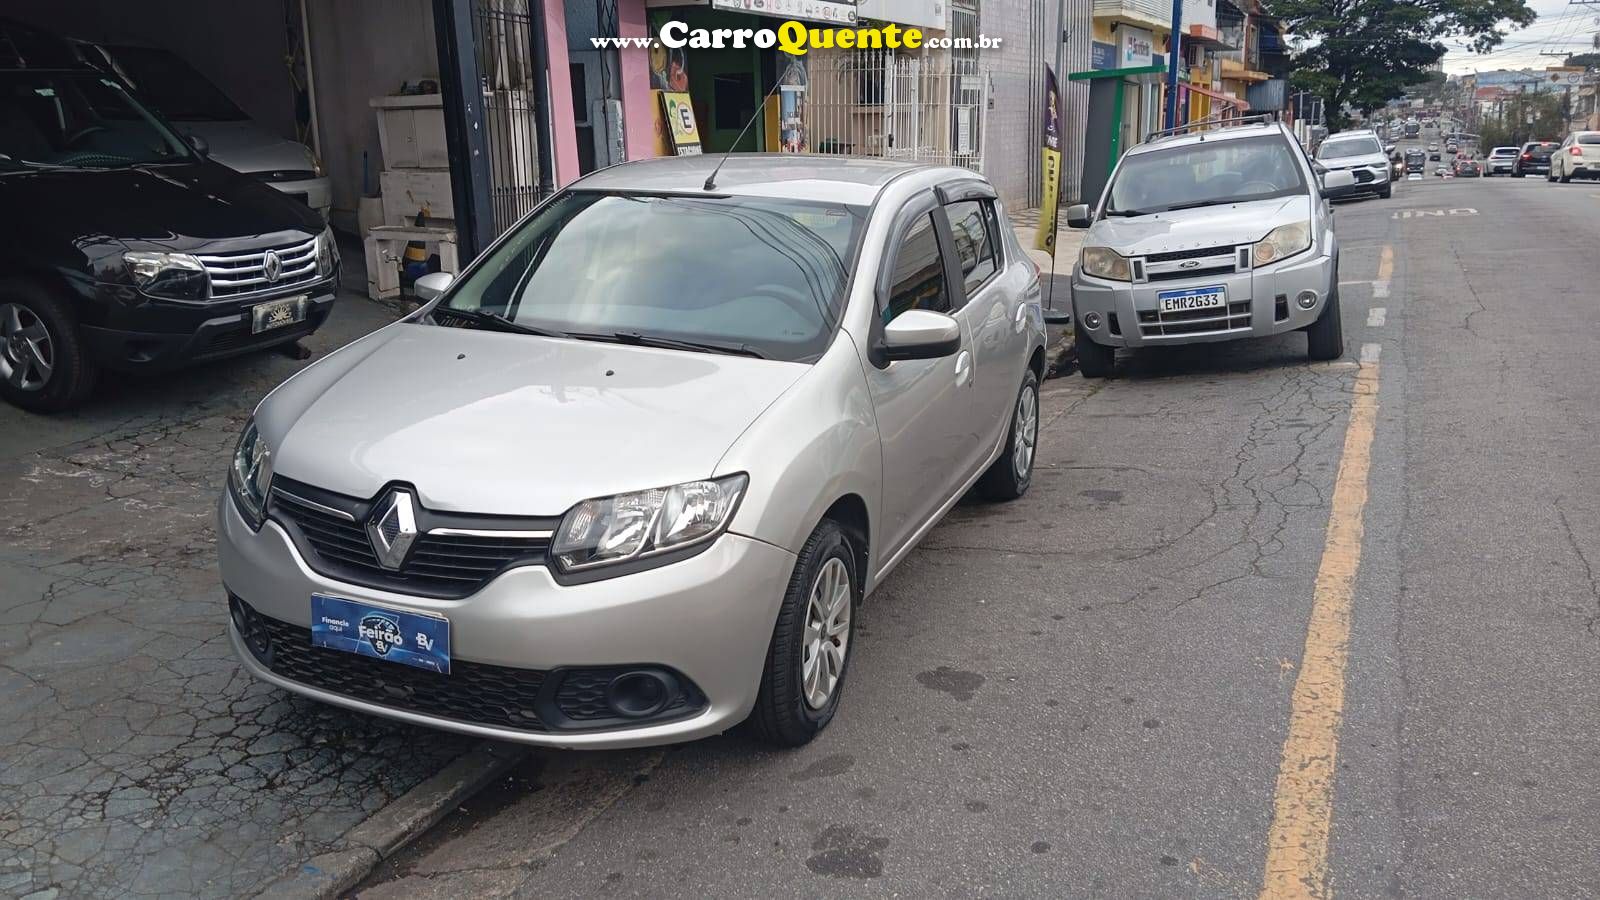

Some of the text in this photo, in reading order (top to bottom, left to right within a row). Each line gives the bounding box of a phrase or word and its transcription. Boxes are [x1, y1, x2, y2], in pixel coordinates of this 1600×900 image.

[680, 108, 692, 129] E
[1165, 294, 1218, 310] EMR2G33
[321, 616, 349, 627] Financia
[358, 625, 403, 646] Feirão
[415, 632, 434, 651] BV
